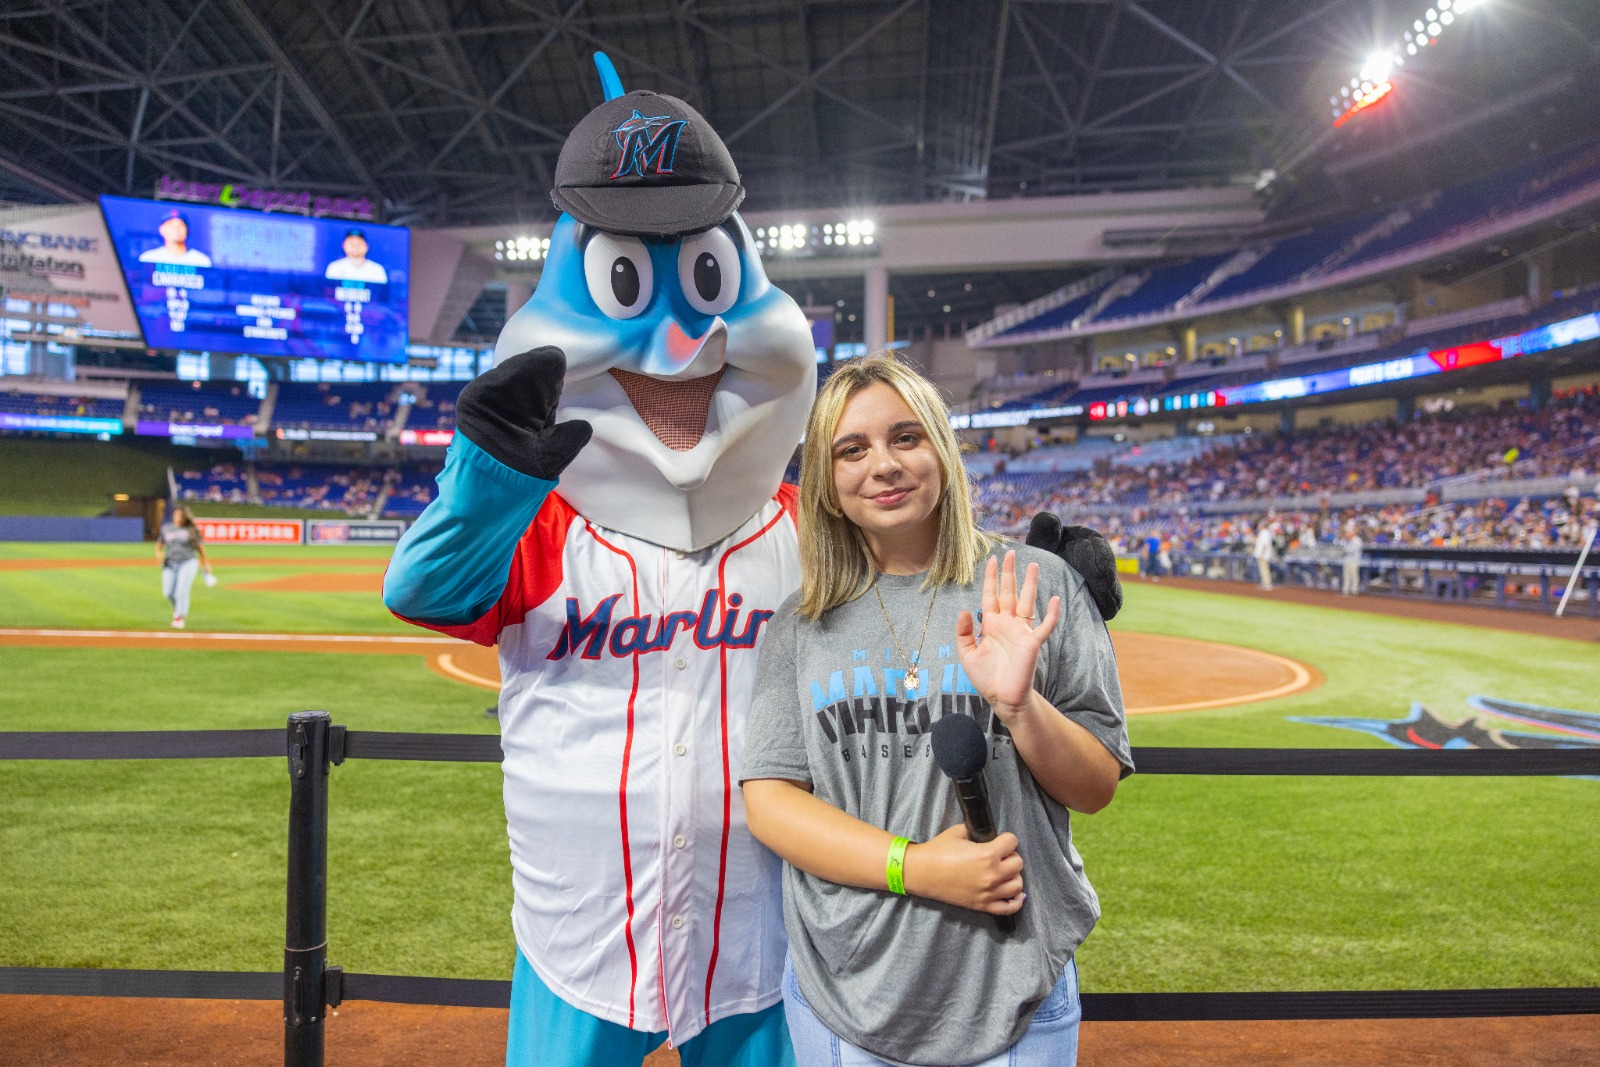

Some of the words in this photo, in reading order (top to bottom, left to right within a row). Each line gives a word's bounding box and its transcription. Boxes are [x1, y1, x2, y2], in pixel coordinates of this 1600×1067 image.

[609, 120, 688, 179] M
[199, 524, 295, 539] RAFTSMAN
[546, 588, 776, 661] Marlin
[852, 645, 951, 663] MIAM
[810, 663, 1012, 743] MARLIN
[842, 744, 999, 763] BASEBL
